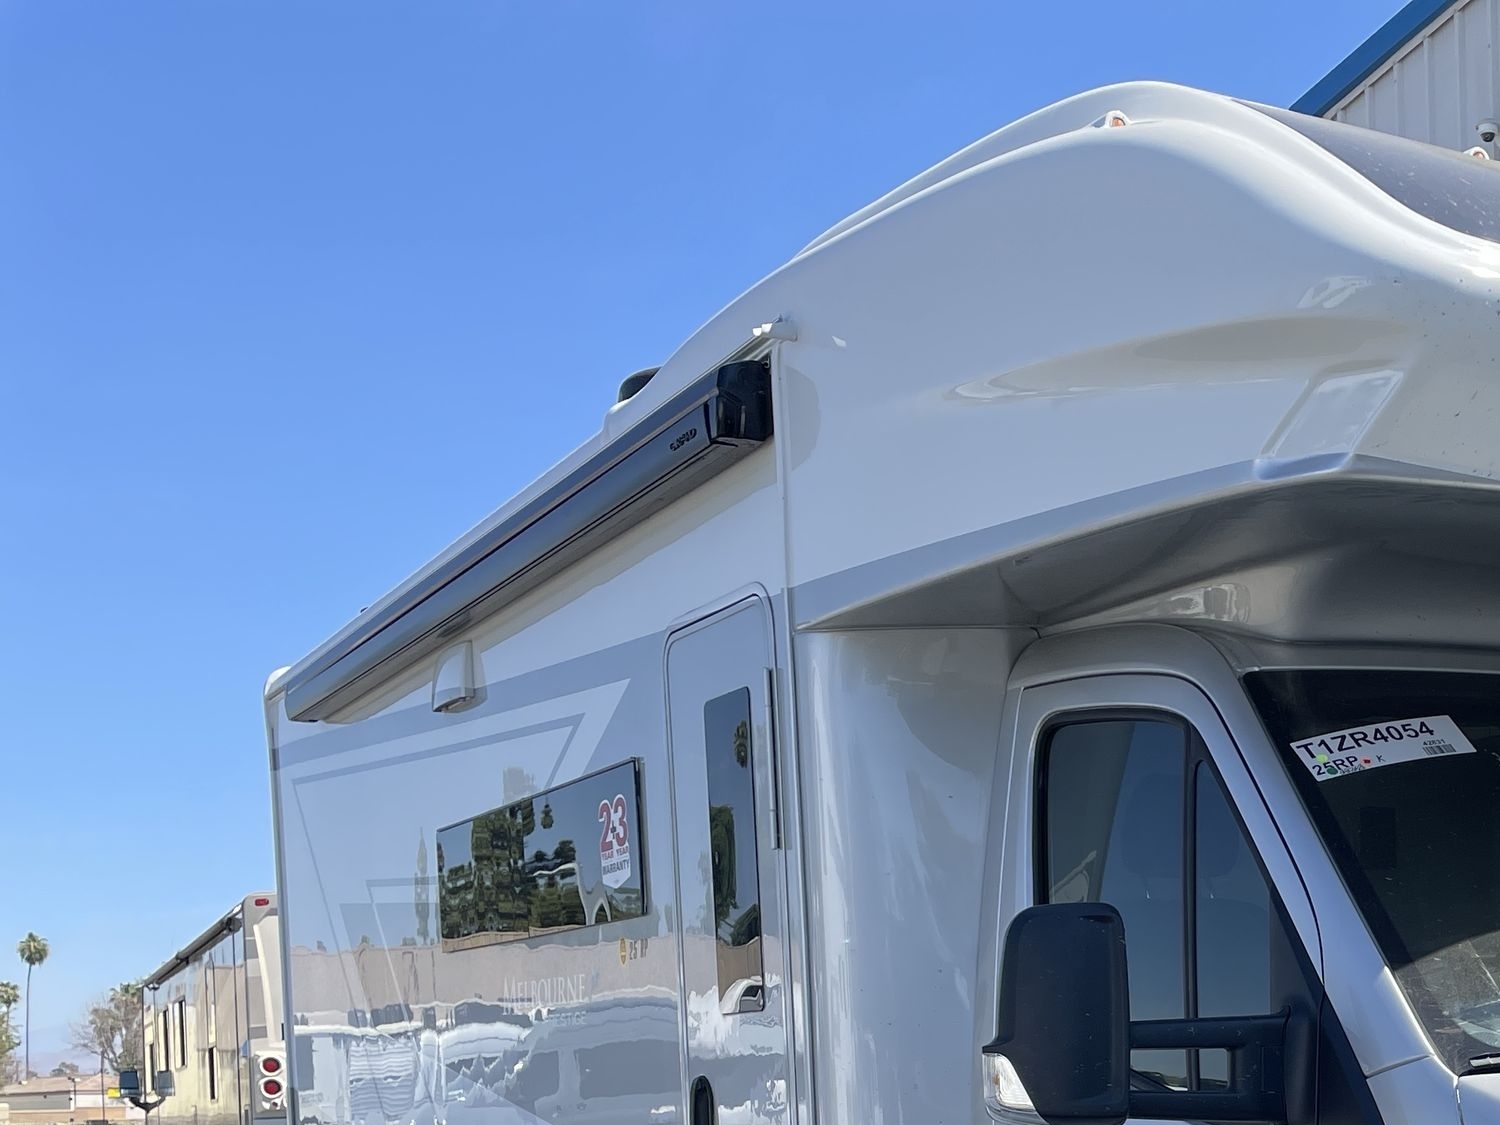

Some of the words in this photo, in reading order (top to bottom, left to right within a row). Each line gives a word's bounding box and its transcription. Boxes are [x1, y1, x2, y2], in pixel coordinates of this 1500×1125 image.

[1296, 721, 1435, 760] T1ZR4054
[1312, 755, 1359, 776] 25RP
[603, 858, 630, 875] WARRANTY
